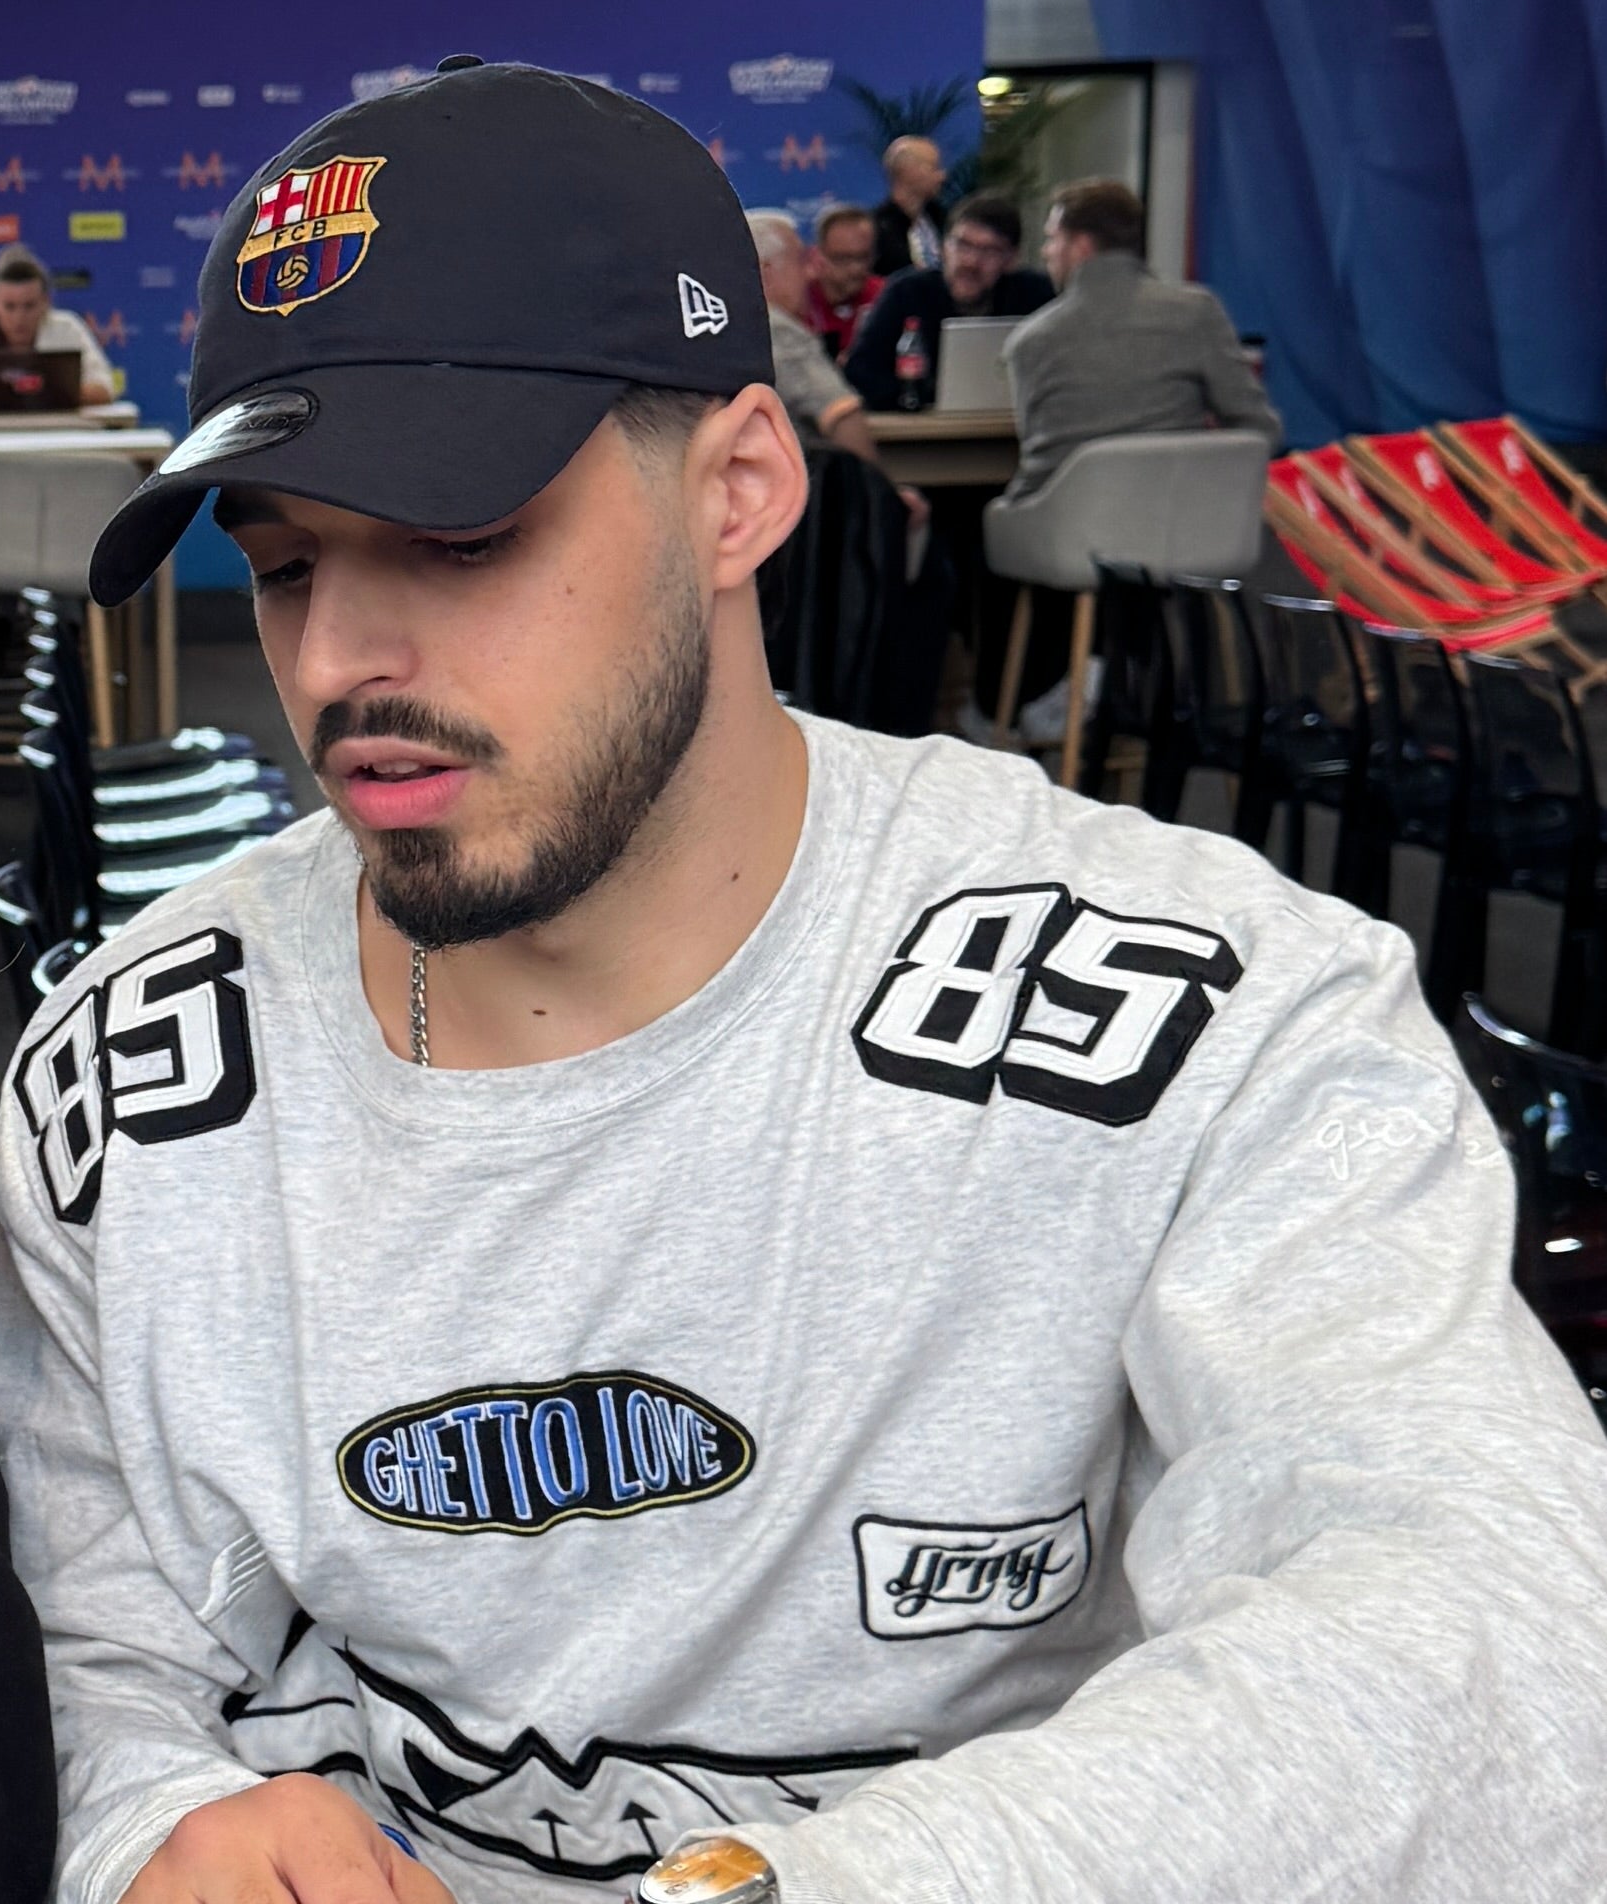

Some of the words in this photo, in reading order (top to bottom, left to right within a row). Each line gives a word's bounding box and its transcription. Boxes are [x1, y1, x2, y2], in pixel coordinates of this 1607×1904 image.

[272, 219, 328, 249] FCB
[13, 926, 258, 1226] 85
[852, 881, 1245, 1128] 85
[361, 1395, 590, 1521] GHETTO
[597, 1385, 725, 1501] LOVE
